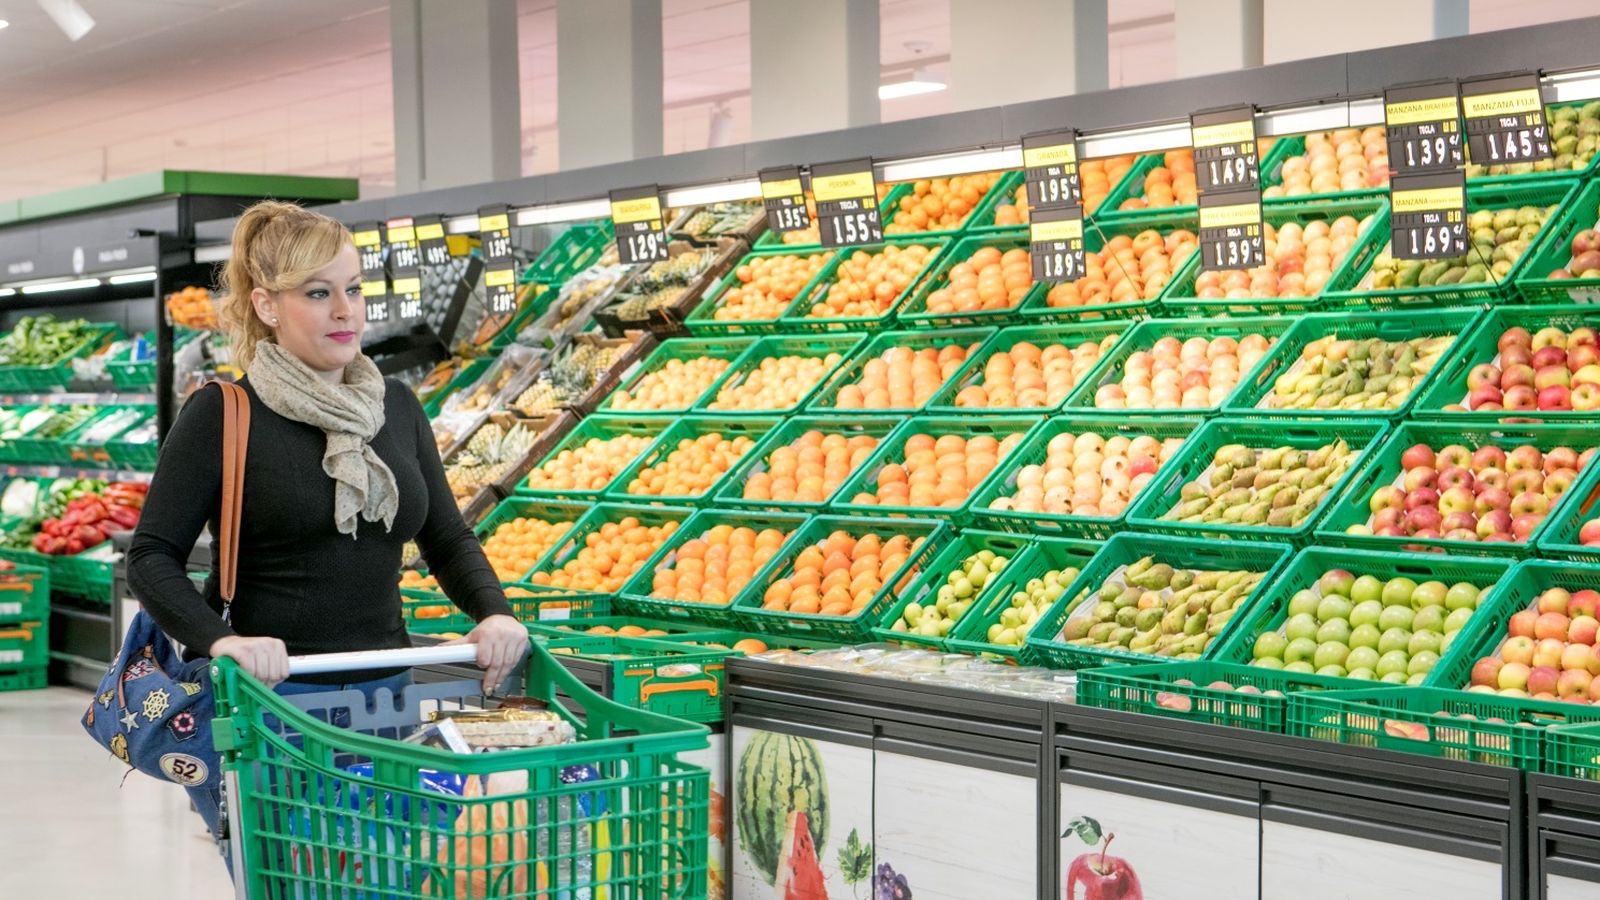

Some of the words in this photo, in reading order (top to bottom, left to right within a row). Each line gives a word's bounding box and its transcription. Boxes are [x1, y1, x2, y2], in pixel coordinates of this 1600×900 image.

[1388, 104, 1423, 114] MANZANA
[1473, 100, 1514, 112] MANZANA
[1418, 125, 1436, 135] TECLA
[1499, 117, 1518, 128] TECLA
[1407, 137, 1446, 166] 139
[1489, 130, 1532, 159] 145
[1210, 158, 1245, 185] 149
[1039, 178, 1069, 202] 195
[839, 200, 859, 210] TECLA
[1395, 197, 1428, 206] MANZANA
[776, 208, 801, 229] 135
[833, 213, 869, 244] 155
[1423, 214, 1440, 223] TECLA
[629, 233, 657, 262] 129
[1411, 227, 1450, 254] 169
[1215, 239, 1250, 266] 139
[1045, 253, 1073, 277] 189
[172, 758, 198, 779] 52
